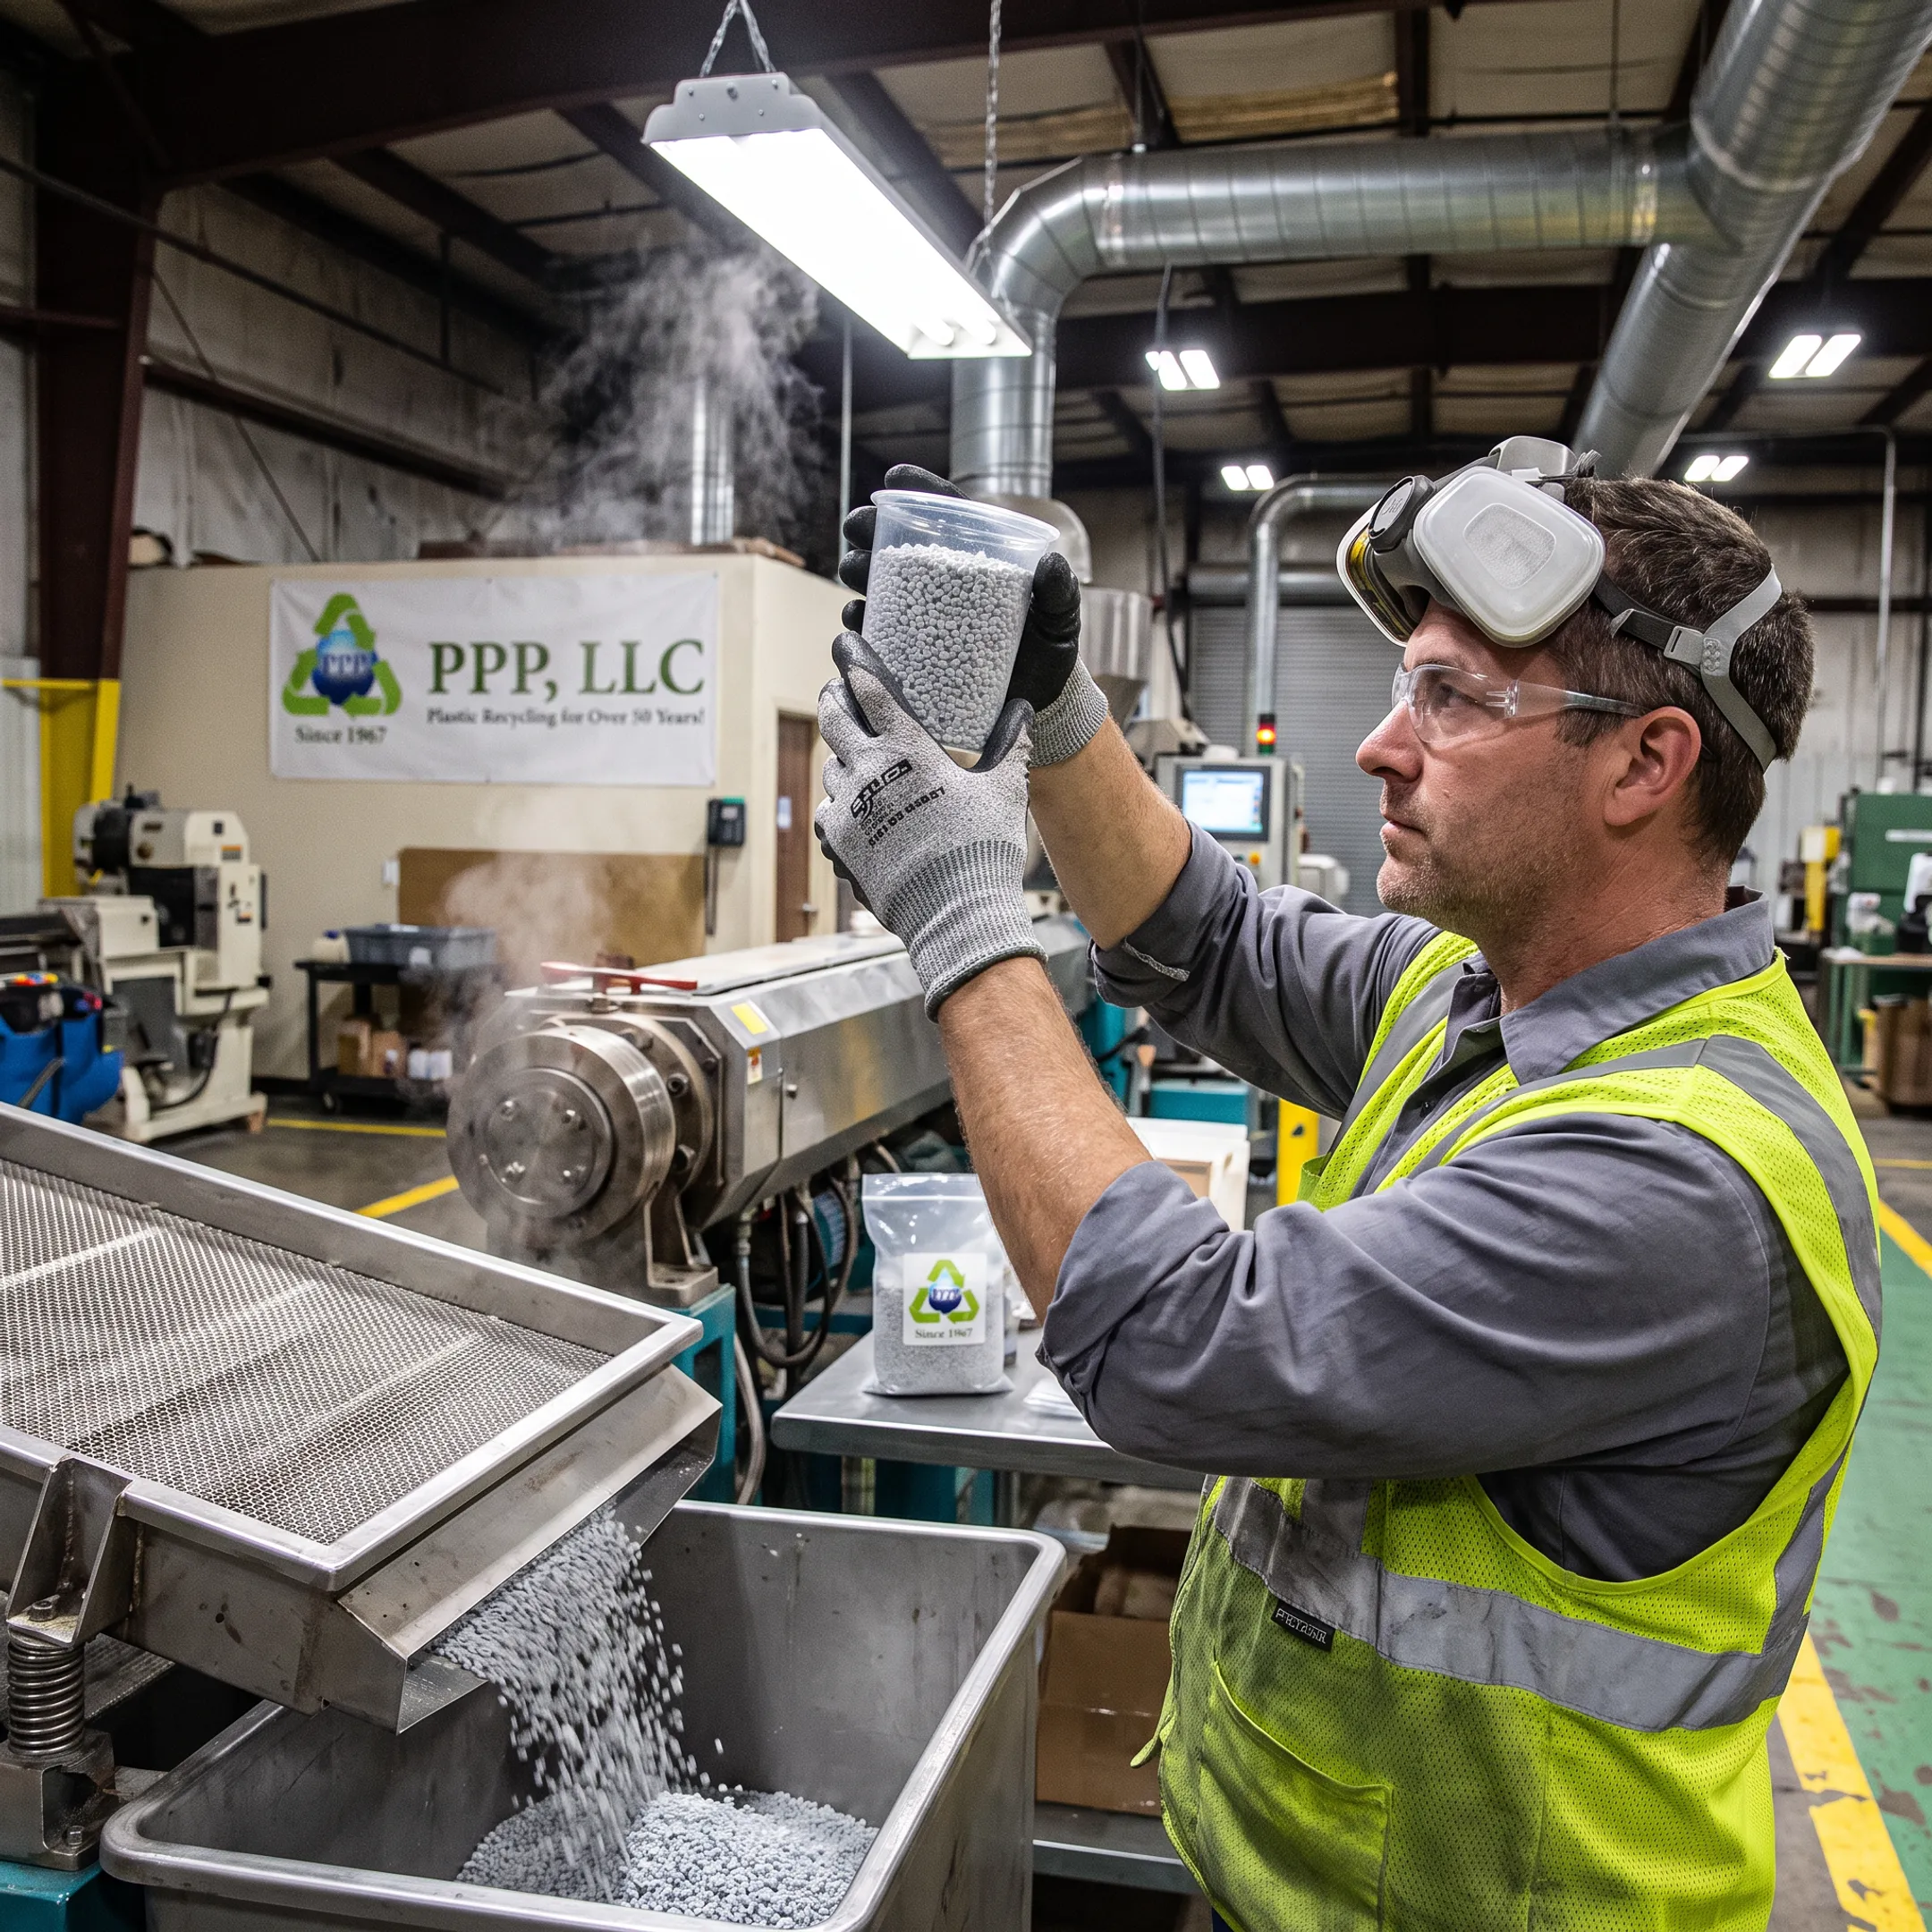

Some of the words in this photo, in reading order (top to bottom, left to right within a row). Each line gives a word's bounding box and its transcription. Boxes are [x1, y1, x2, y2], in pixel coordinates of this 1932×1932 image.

[428, 641, 558, 703] PPP,
[577, 638, 705, 695] LLC
[427, 707, 478, 724] Plastic
[481, 707, 557, 730] Recycling
[587, 708, 627, 725] Over
[656, 707, 705, 725] Years!
[295, 724, 343, 744] Since
[347, 724, 387, 744] 1967
[915, 1328, 945, 1339] Since
